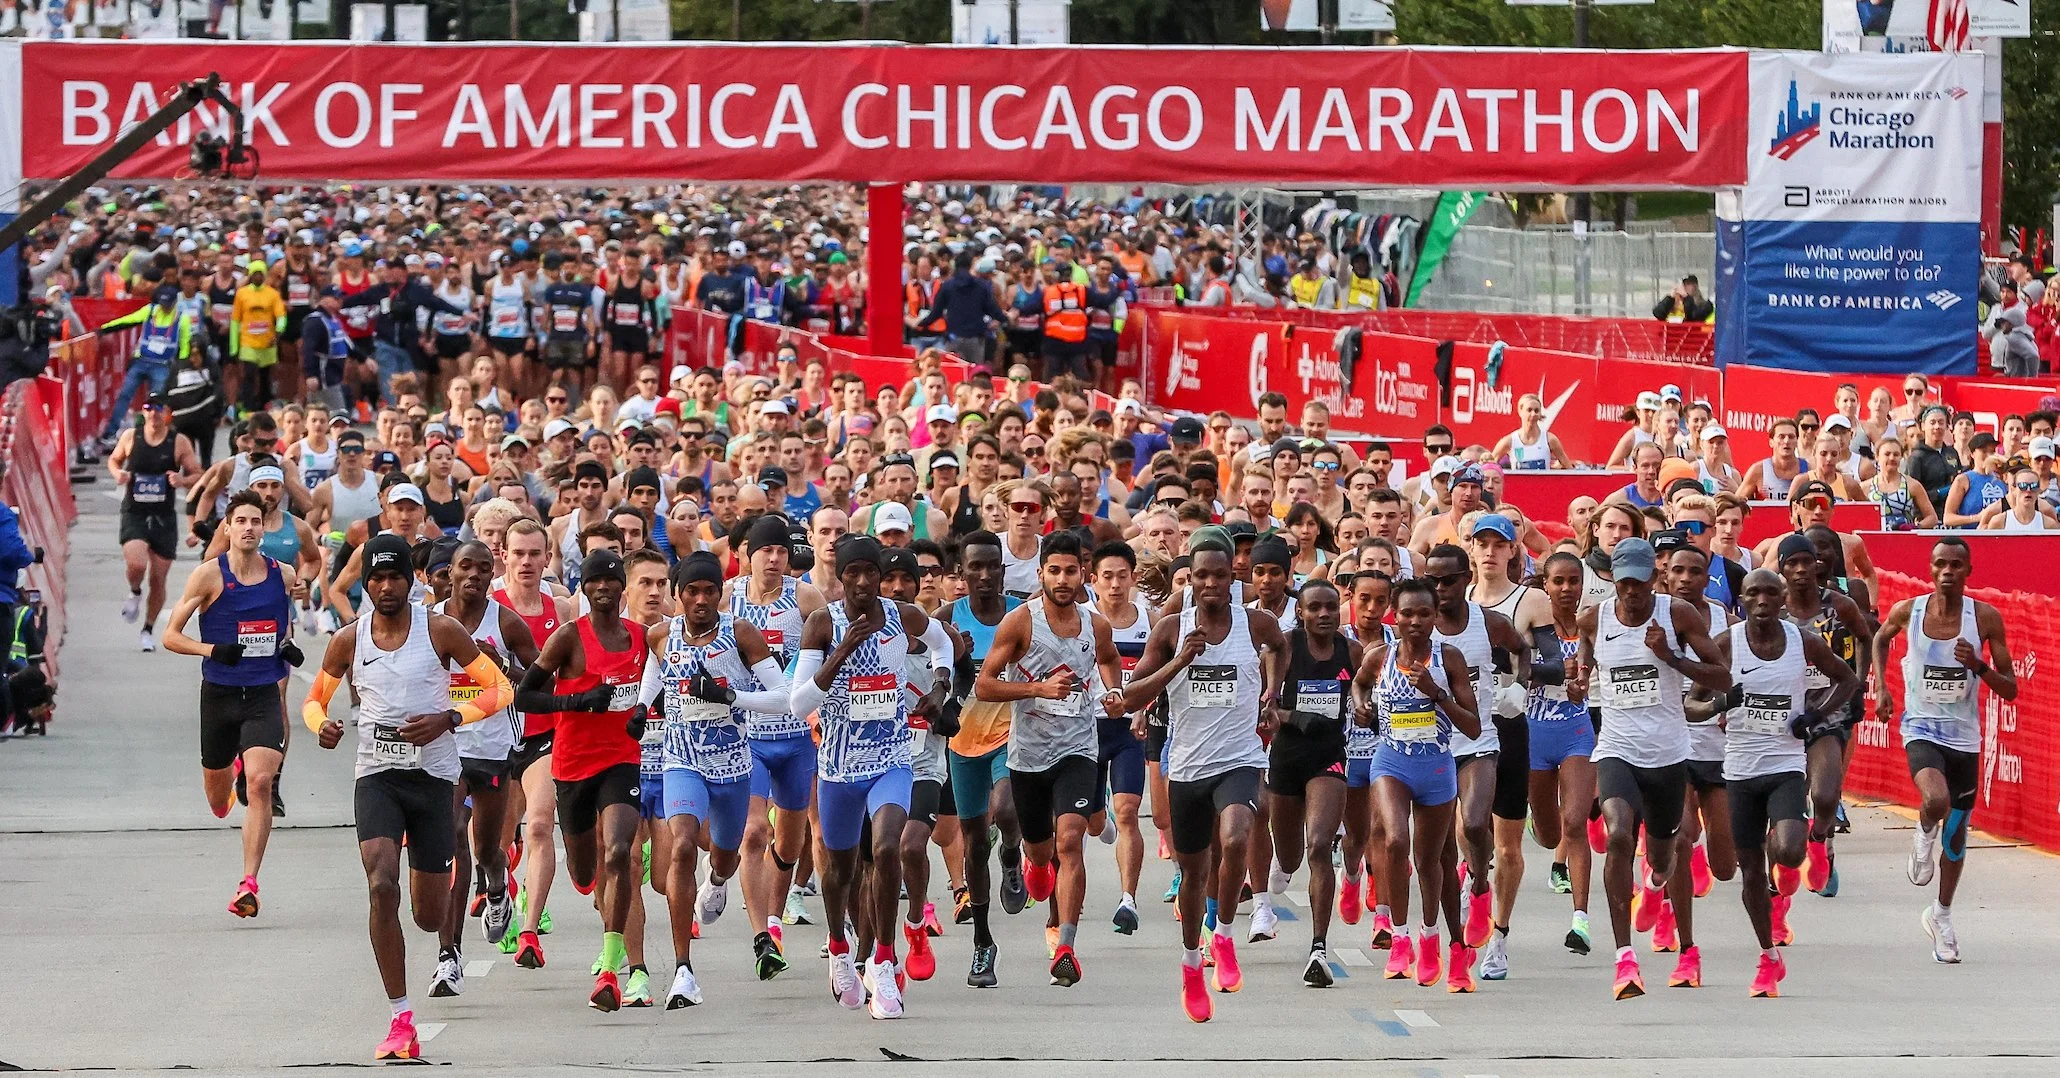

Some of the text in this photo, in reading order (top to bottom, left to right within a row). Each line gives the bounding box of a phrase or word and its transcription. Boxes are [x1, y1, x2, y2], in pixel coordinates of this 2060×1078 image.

[1830, 90, 1941, 101] BANK OF AMERICA
[62, 80, 1699, 153] BANK OF AMERICA CHICAGO MARATHON
[1830, 107, 1915, 130] Chicago
[1829, 130, 1934, 149] Marathon
[1815, 189, 1851, 197] ABBOTT
[1815, 197, 1947, 206] WORLD MARATHON MAJORS
[1805, 244, 1923, 265] What would you
[1785, 264, 1942, 283] like the power to do?
[1768, 293, 1923, 311] BANK OF AMERICA
[1475, 381, 1513, 416] Abbott
[1596, 402, 1615, 422] BANK
[1726, 409, 1753, 431] BANK
[1755, 413, 1766, 432] OF
[1589, 587, 1605, 595] ZAP
[239, 634, 275, 645] KREMSKE
[611, 684, 639, 699] KORIR
[1191, 682, 1234, 693] PACE 3
[1615, 680, 1657, 695] PACE 2
[1926, 681, 1965, 691] PACE 4
[851, 692, 896, 706] KIPTUM
[1391, 715, 1435, 726] CHEPNGETICH
[1747, 708, 1788, 722] PACE 9
[374, 741, 407, 756] PACE
